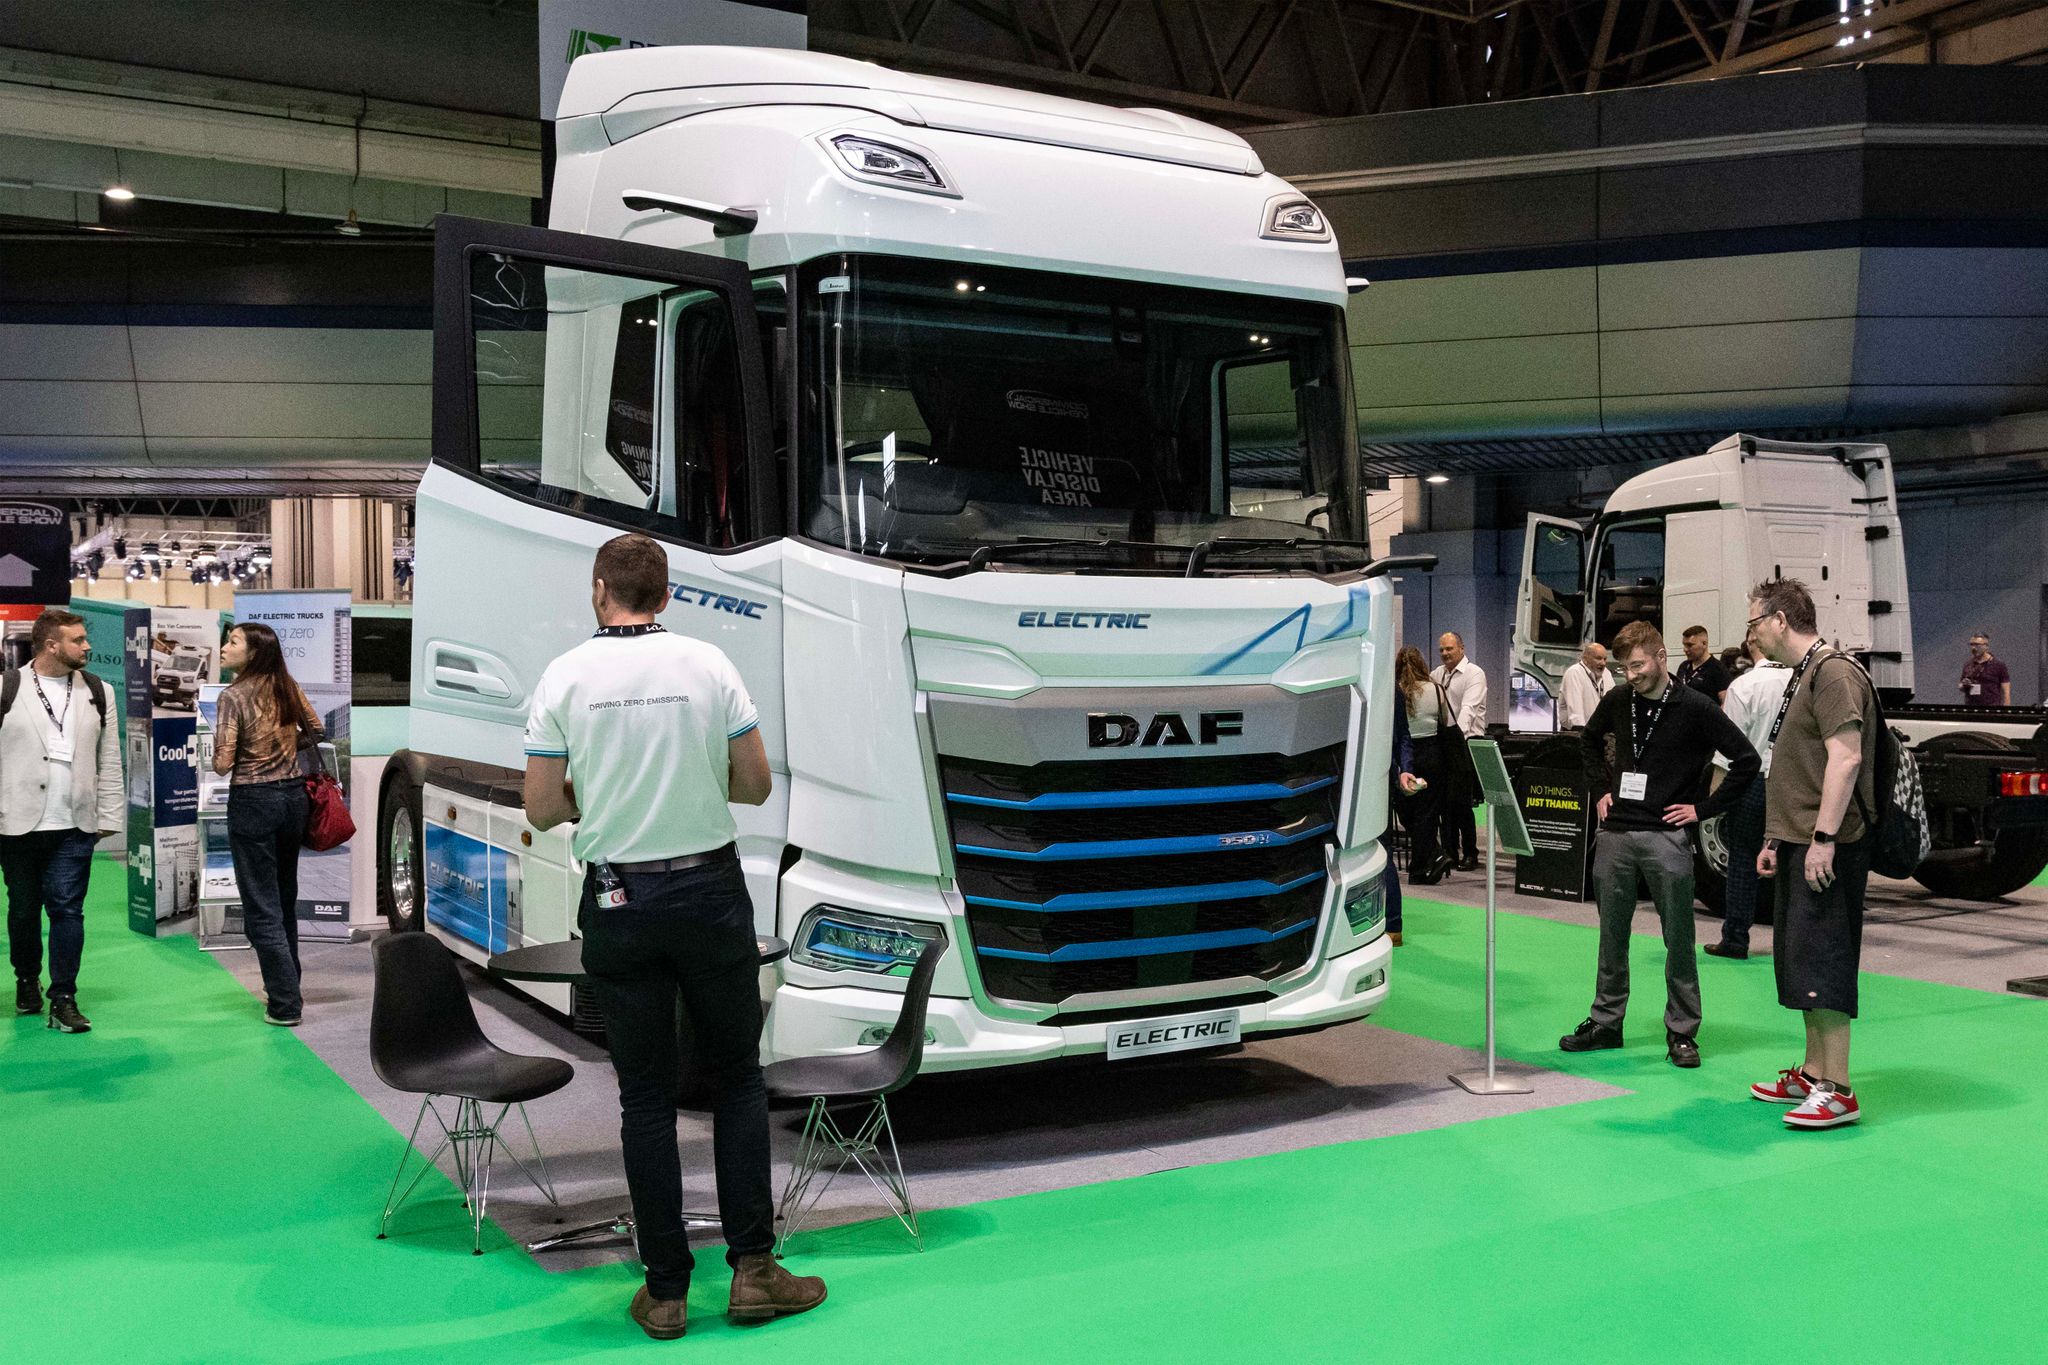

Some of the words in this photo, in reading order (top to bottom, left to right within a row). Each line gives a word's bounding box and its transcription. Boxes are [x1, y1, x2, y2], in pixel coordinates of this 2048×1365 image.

[18, 516, 62, 525] SHOW
[297, 612, 324, 620] TRUCKS
[1017, 611, 1151, 630] ELECTRIC
[289, 627, 315, 639] zero
[589, 700, 622, 711] DRIVING
[623, 698, 645, 707] ZERO
[646, 695, 689, 705] EMISSIONS
[1086, 709, 1245, 749] DAF
[159, 744, 187, 761] Cool
[1530, 784, 1543, 795] NO
[1525, 797, 1545, 808] JUST
[1545, 799, 1581, 811] THANKS.
[314, 904, 342, 912] DAF
[1116, 1019, 1233, 1048] ELECTRIC
